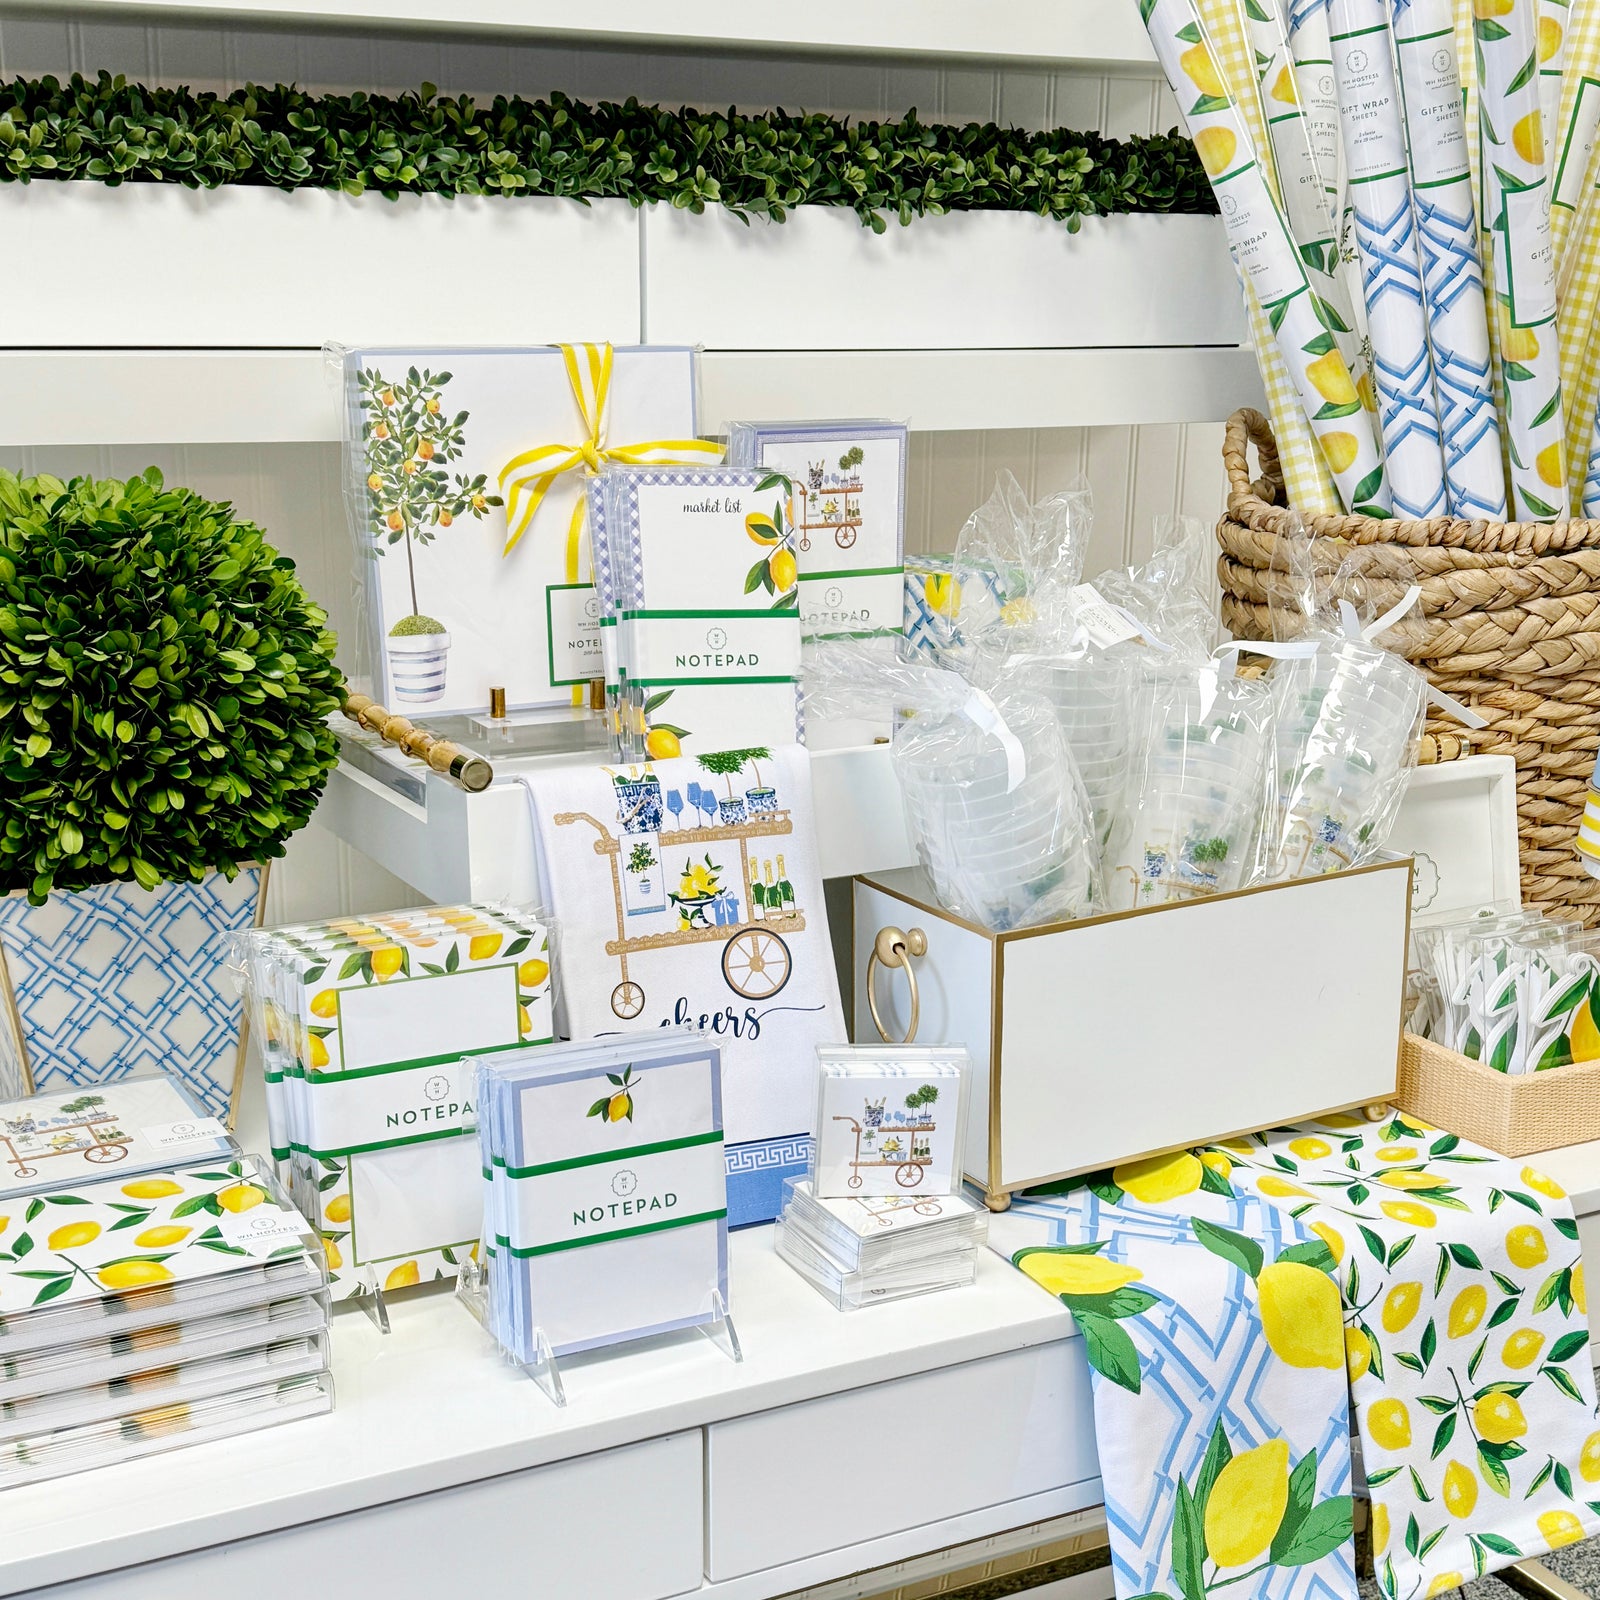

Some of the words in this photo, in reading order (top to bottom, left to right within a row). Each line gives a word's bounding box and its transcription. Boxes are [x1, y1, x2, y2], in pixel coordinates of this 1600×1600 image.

[1341, 104, 1359, 115] GIFT
[1362, 97, 1390, 110] WRAP
[1421, 105, 1443, 116] GIFT
[1351, 111, 1378, 122] SHEETS
[1242, 231, 1268, 247] WRAP
[1531, 246, 1549, 260] GIFT
[683, 498, 721, 514] market
[724, 498, 742, 514] list
[568, 639, 602, 649] NOTE
[675, 654, 759, 667] NOTEPAD
[386, 1101, 479, 1128] NOTEPA
[573, 1193, 678, 1226] NOTEPAD
[256, 1225, 300, 1236] HOSTESS
